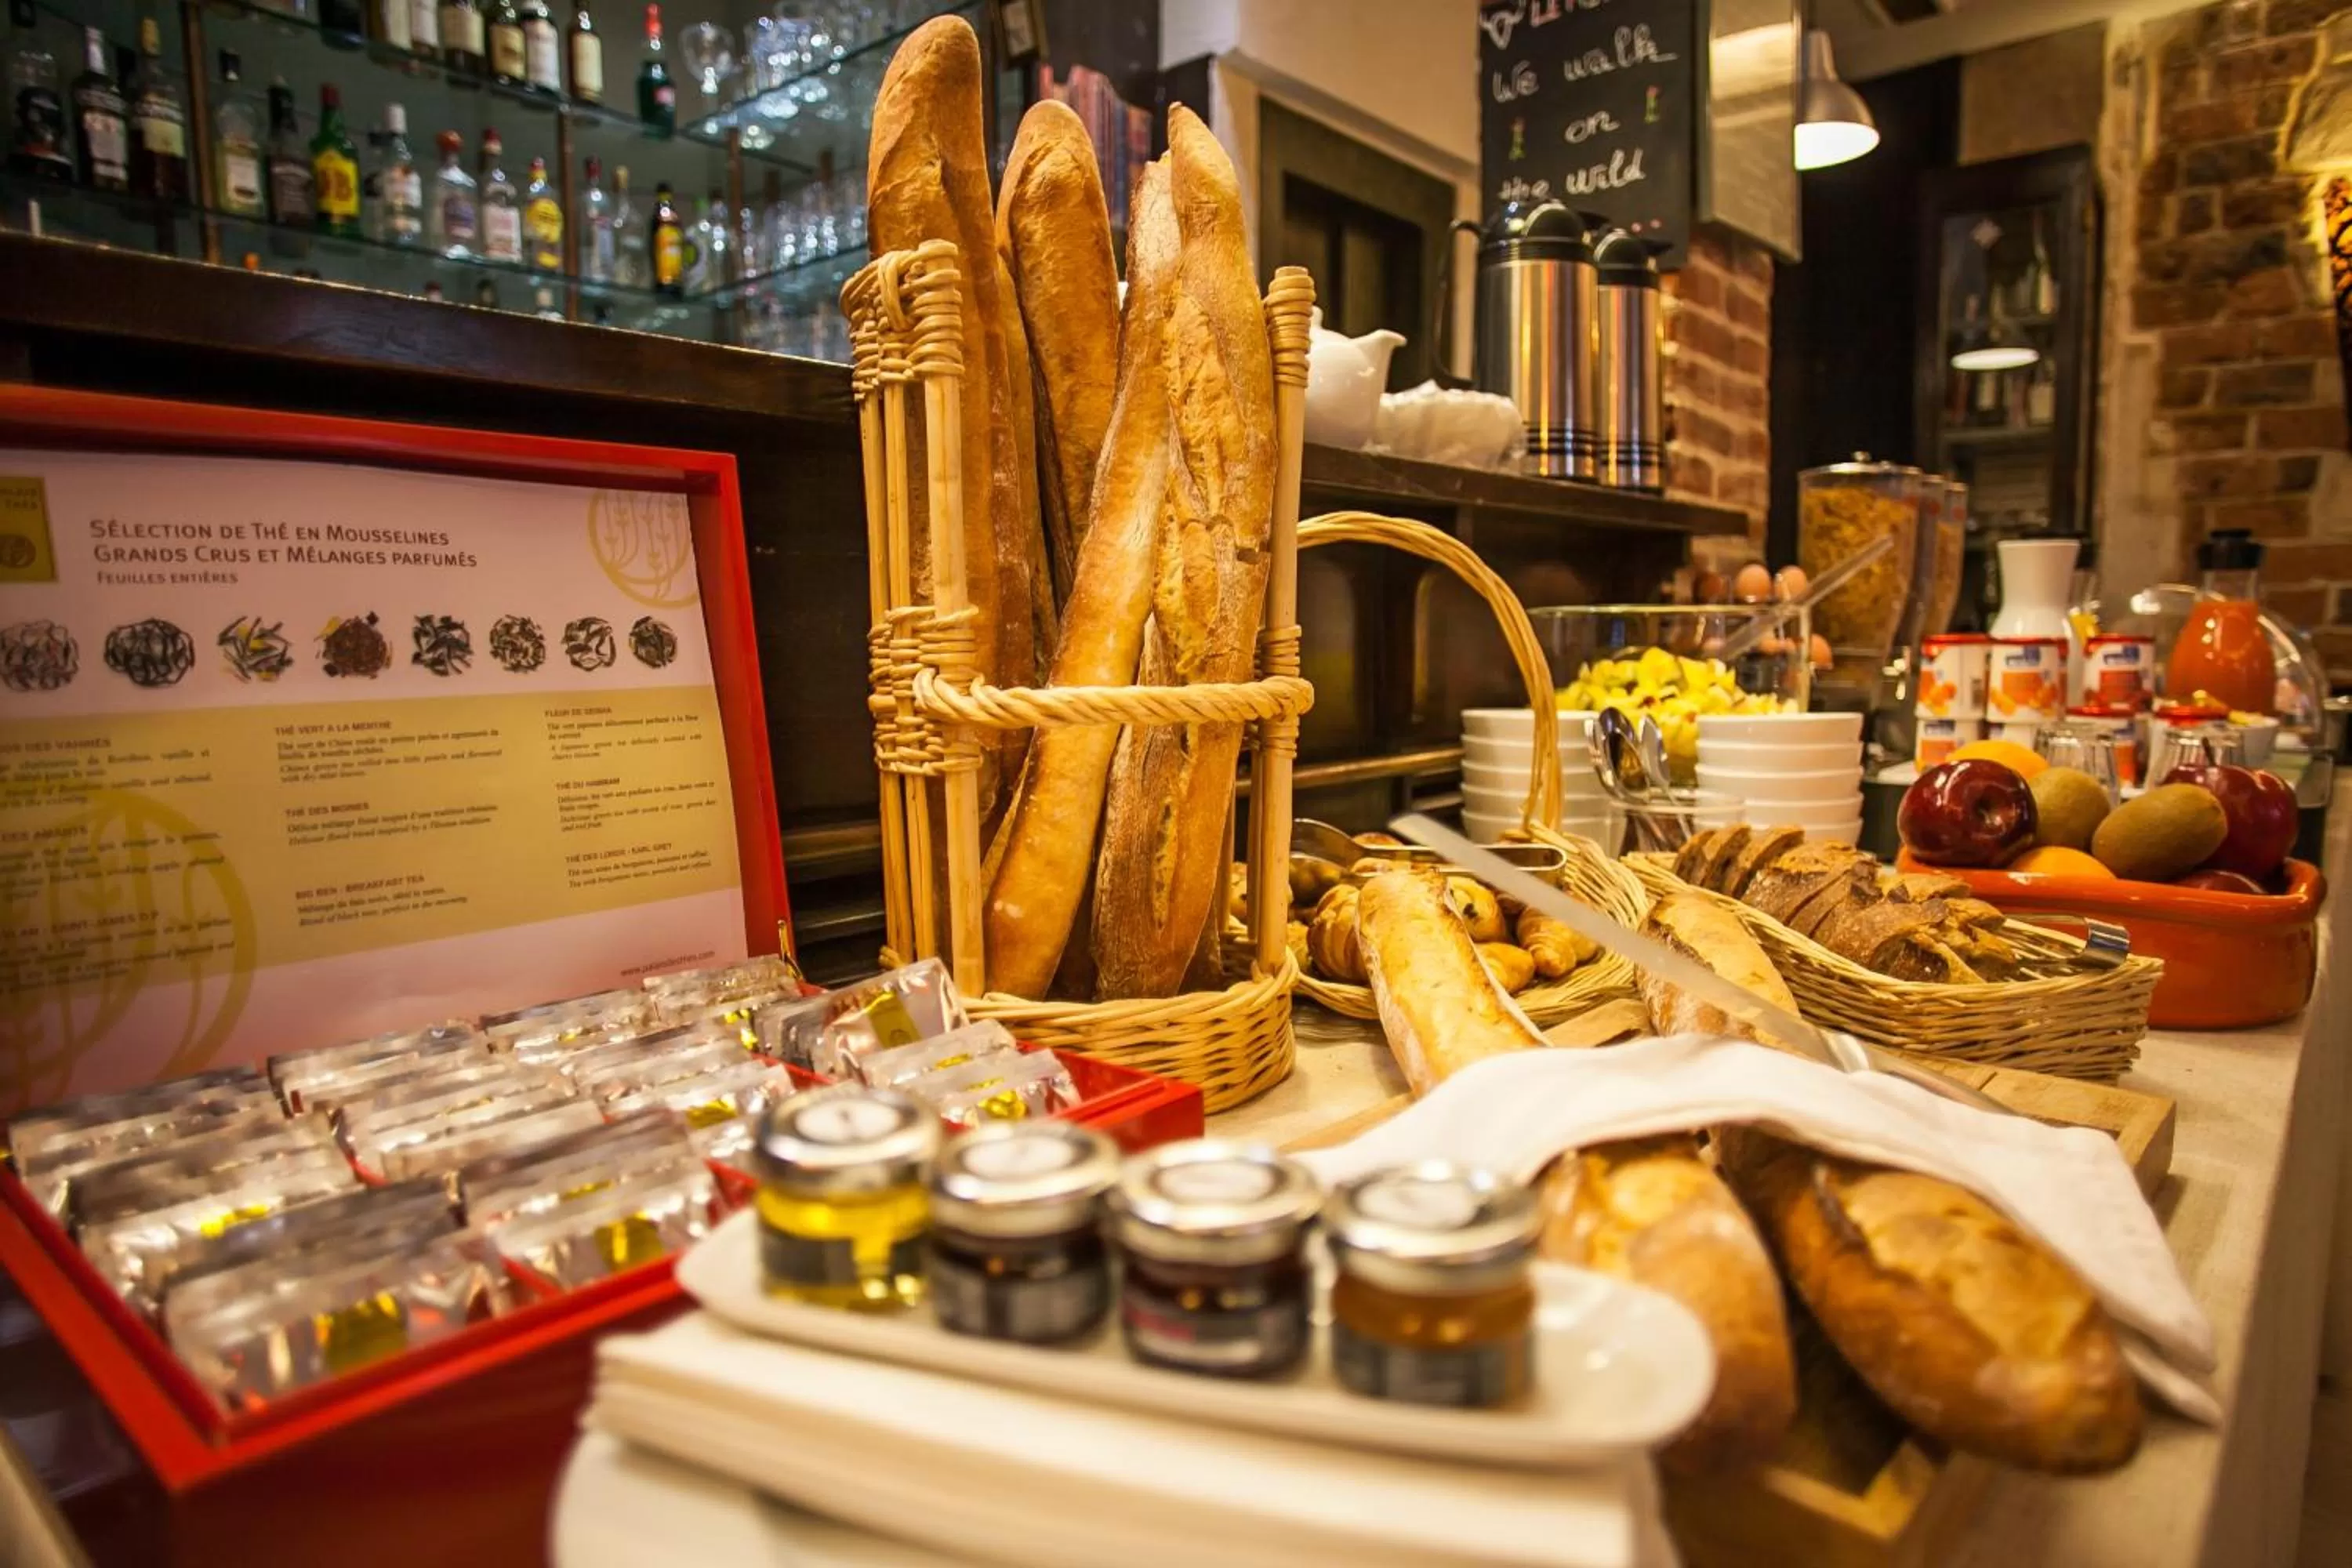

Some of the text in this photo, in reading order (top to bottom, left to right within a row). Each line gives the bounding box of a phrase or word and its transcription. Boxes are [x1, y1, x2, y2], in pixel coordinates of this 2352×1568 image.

[1563, 23, 1679, 81] walk
[1565, 111, 1620, 143] on
[1566, 147, 1646, 195] wild
[89, 519, 450, 546] SÉLECTION DE THÉ EN MOUSSELINES
[93, 544, 478, 568] GRANDS CRUS ET MÉLANGES PARFUMÉS
[96, 569, 239, 585] FEUILLES ENTIÈRES
